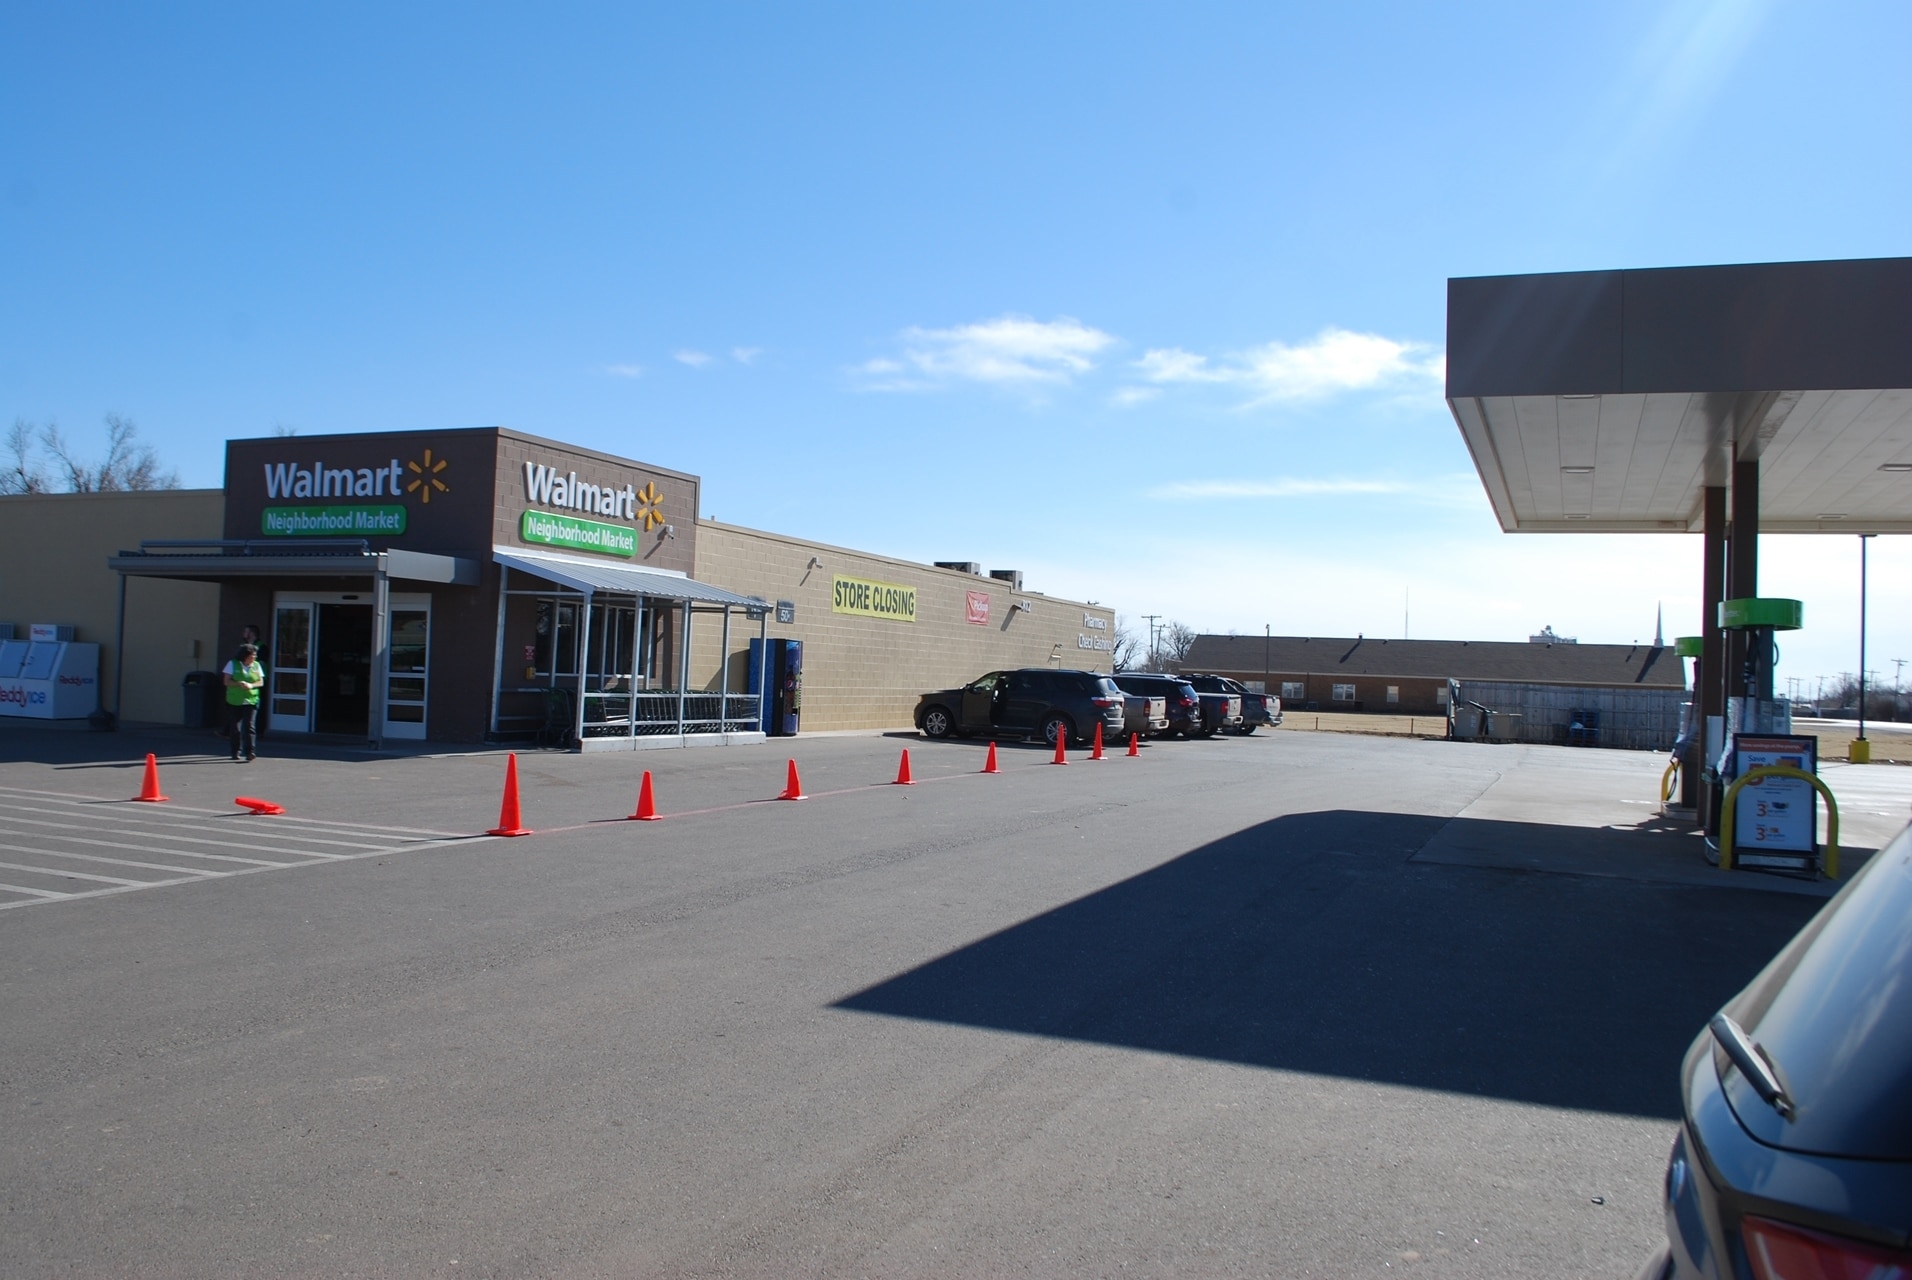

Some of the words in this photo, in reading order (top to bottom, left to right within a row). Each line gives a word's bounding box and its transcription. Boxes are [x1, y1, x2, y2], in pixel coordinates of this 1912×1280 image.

[264, 459, 403, 499] Walmart
[525, 461, 636, 520] Walmart
[267, 511, 353, 534] Neighborhood
[355, 510, 399, 529] Market
[528, 516, 600, 545] Neighborhood
[601, 529, 634, 550] Market
[835, 580, 870, 611] STORE
[872, 588, 915, 616] CLOSING
[1084, 612, 1107, 633] Pharmacy
[1078, 633, 1094, 650] Check
[1748, 754, 1766, 762] Save
